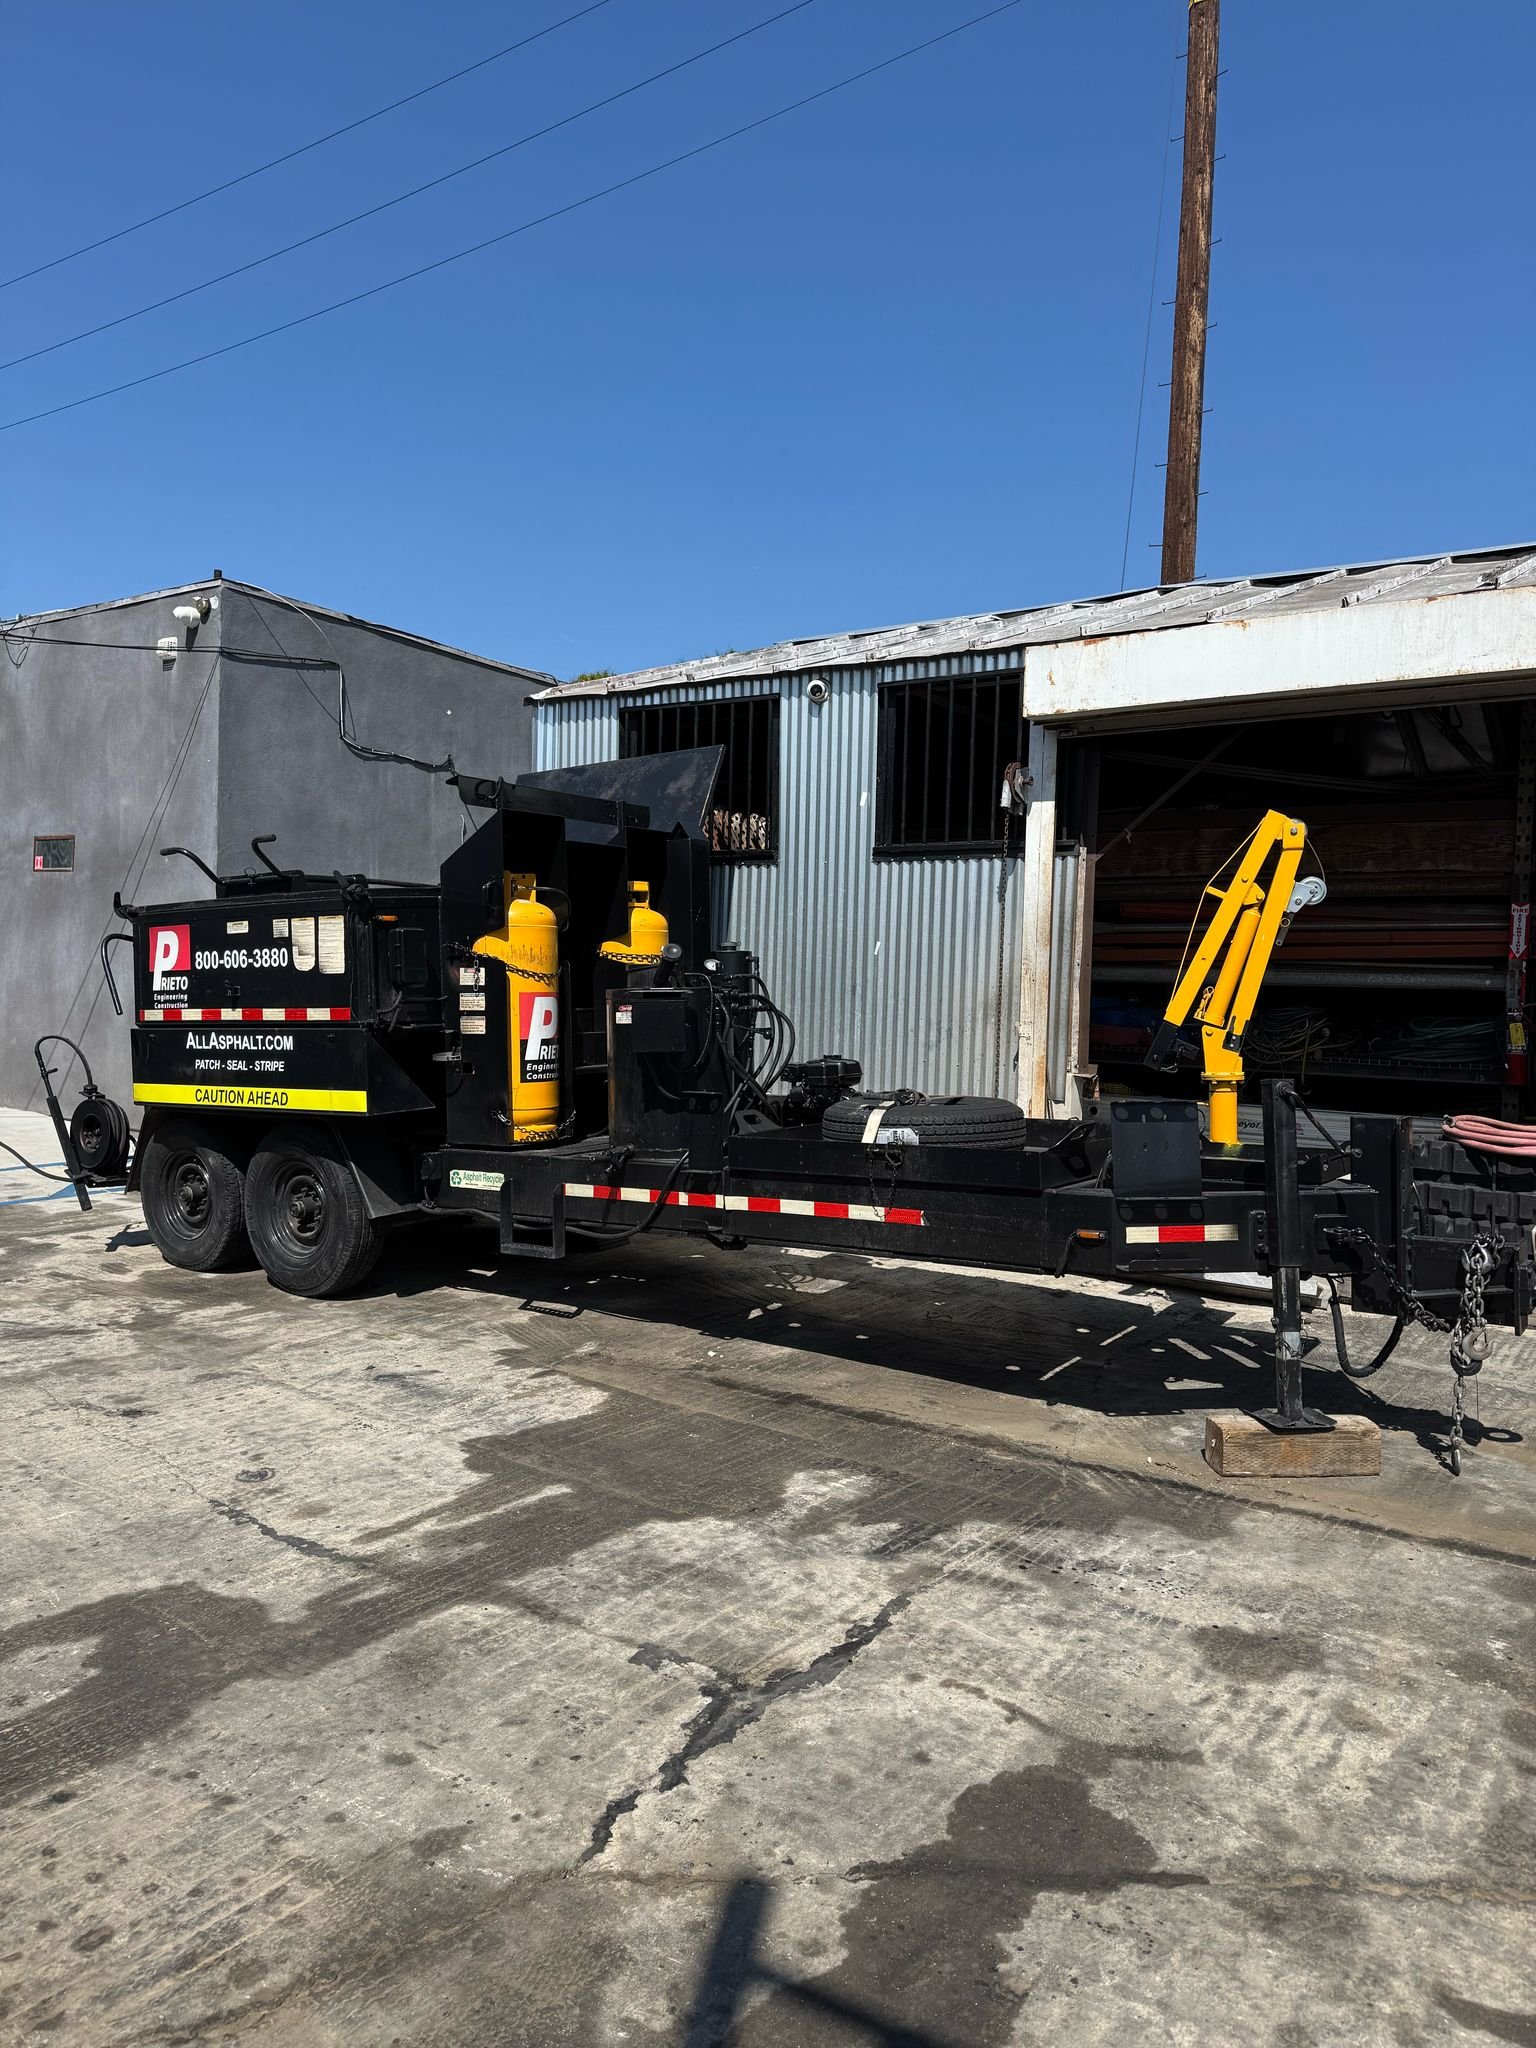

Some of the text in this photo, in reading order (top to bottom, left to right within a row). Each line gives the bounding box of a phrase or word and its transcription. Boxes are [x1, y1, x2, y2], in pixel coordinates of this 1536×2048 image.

[153, 930, 188, 991] PRIETO
[195, 948, 288, 970] 800-606-3880
[154, 993, 188, 1002] Engineering
[195, 1059, 221, 1070] PATCH
[226, 1060, 248, 1071] SEAL
[254, 1061, 285, 1072] STRIPE
[195, 1088, 289, 1106] CAUTION AHEAD
[463, 1172, 482, 1183] Asphalt
